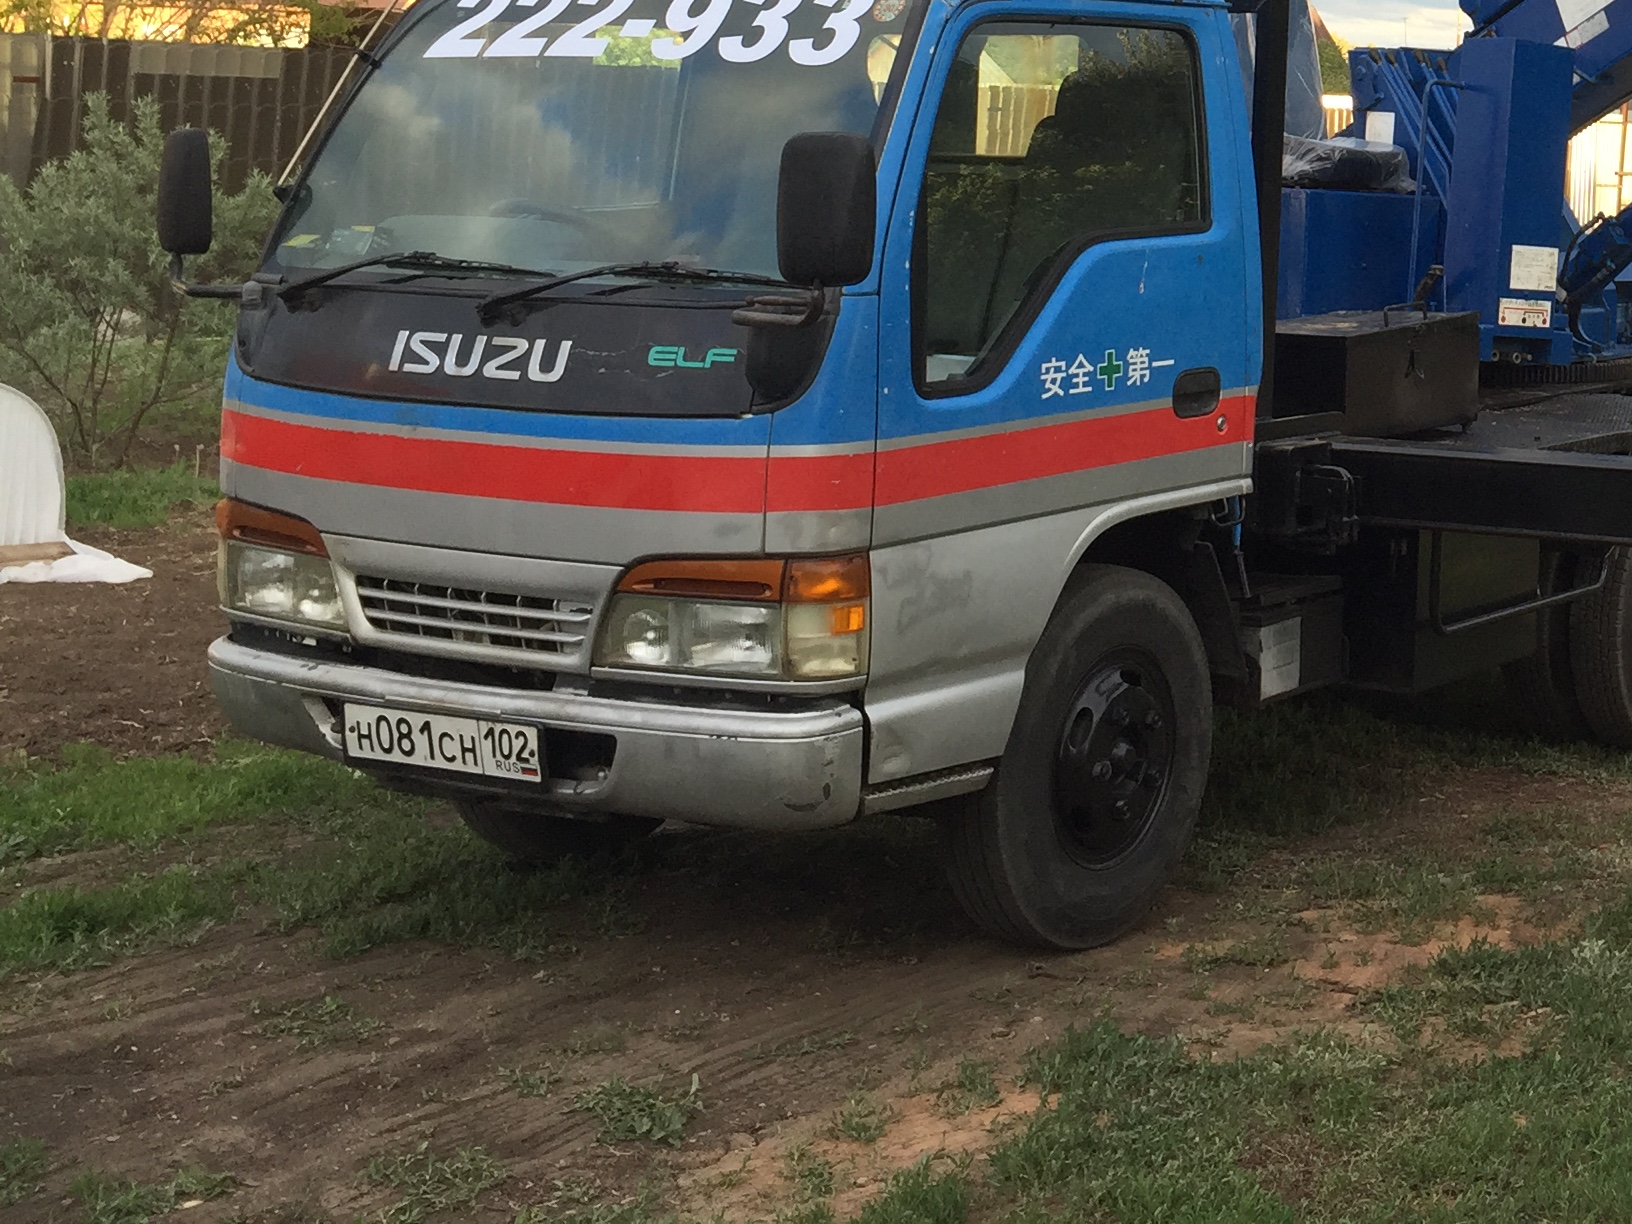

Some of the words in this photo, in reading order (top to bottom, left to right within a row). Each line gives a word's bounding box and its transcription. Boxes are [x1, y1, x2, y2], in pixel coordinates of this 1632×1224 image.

[388, 330, 572, 382] ISUZU
[648, 346, 737, 368] ELF
[484, 727, 530, 763] 102
[495, 760, 520, 774] RUS
